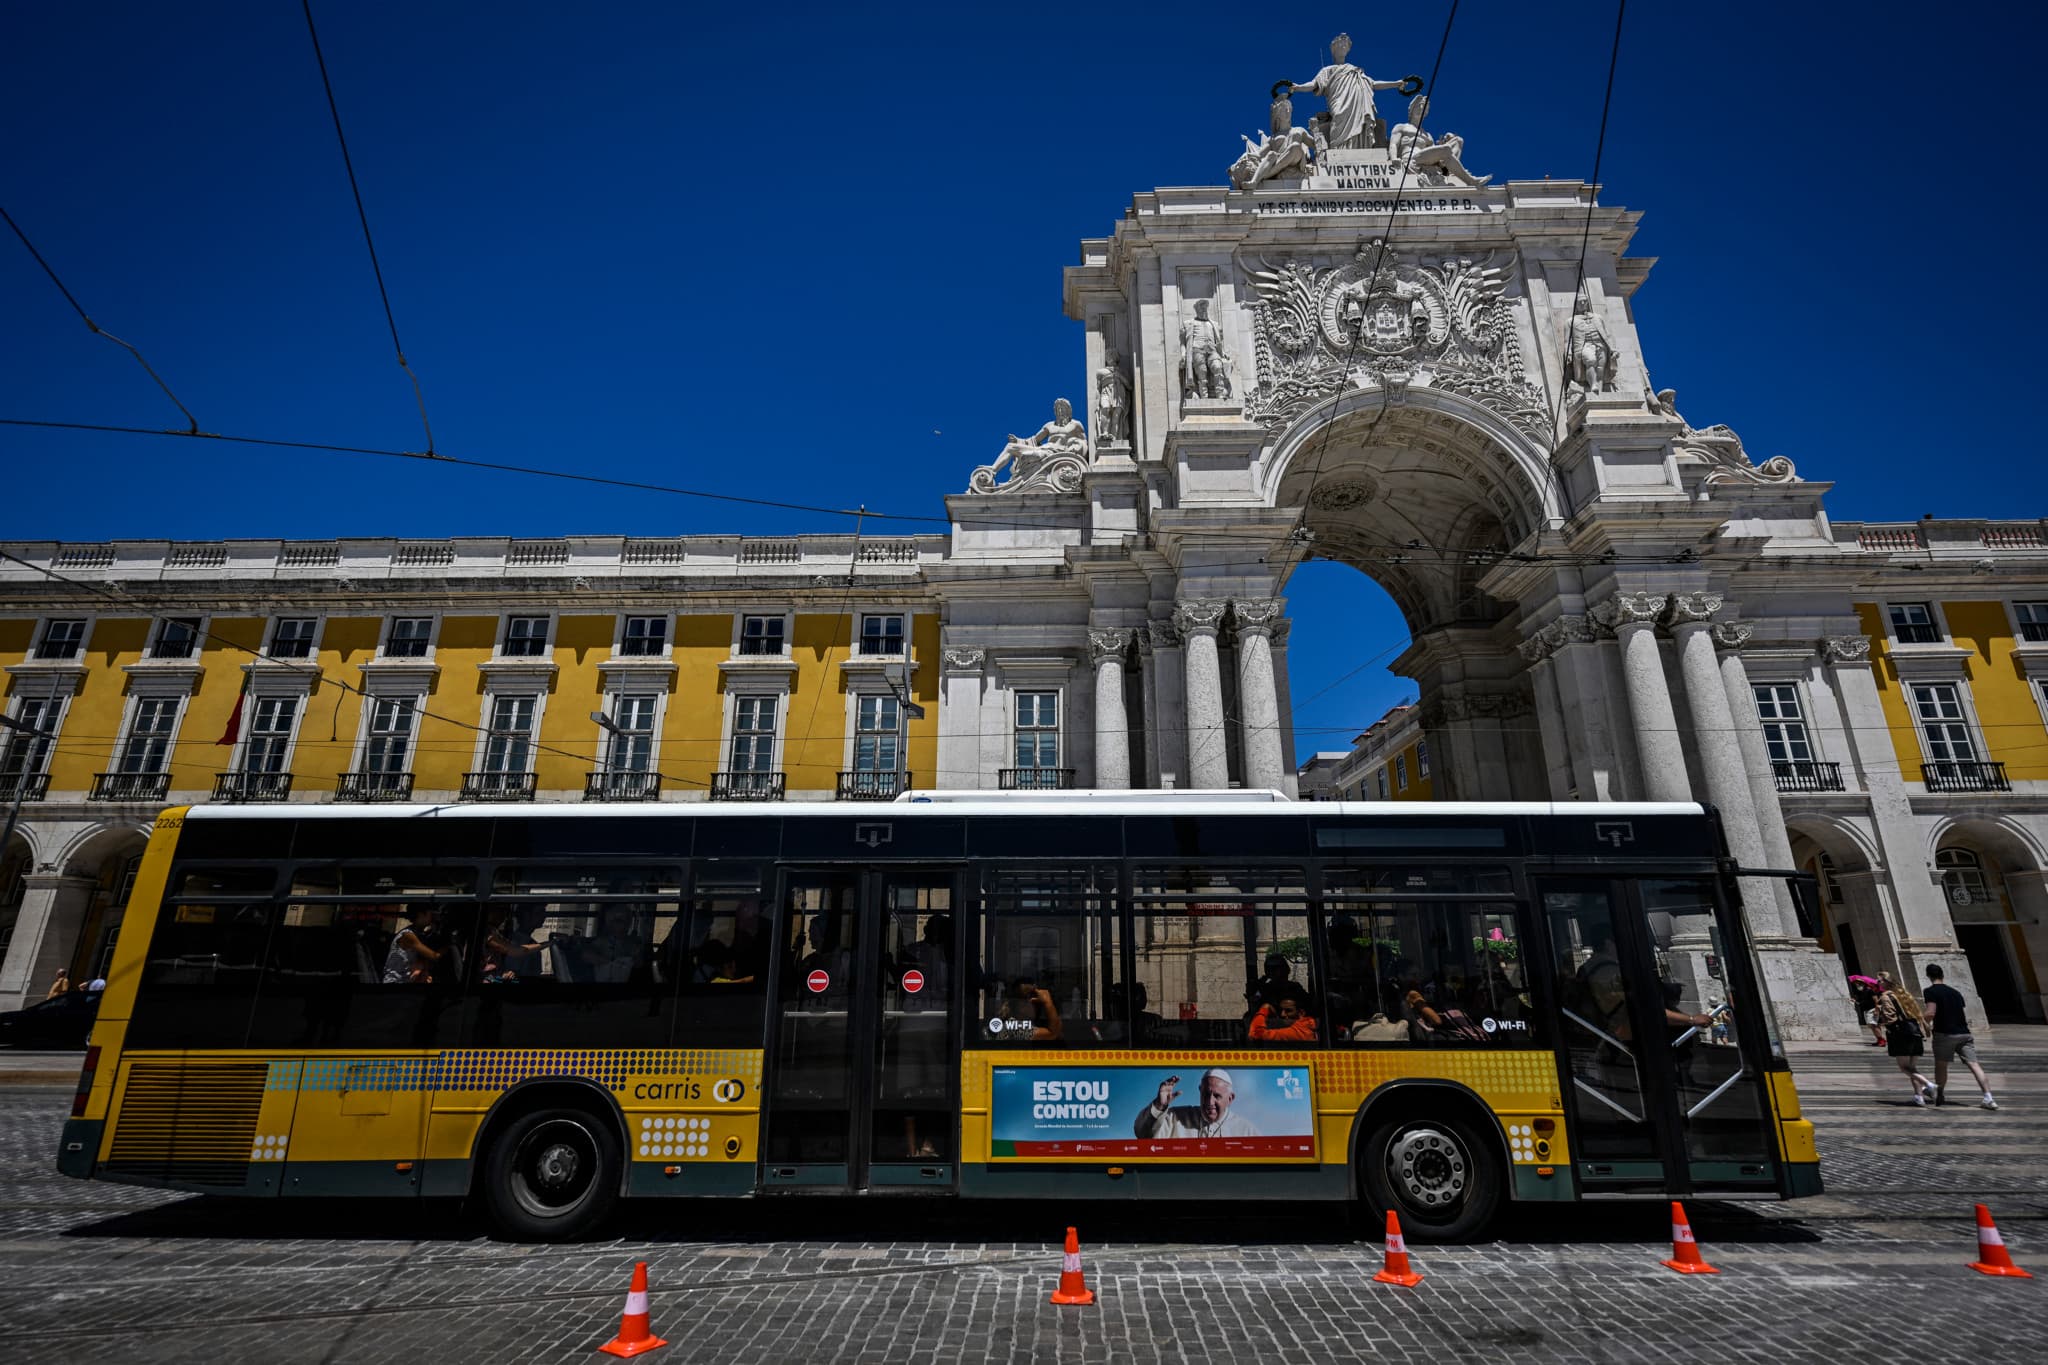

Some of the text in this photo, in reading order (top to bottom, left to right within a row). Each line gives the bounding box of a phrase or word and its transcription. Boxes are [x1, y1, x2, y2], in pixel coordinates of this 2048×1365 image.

[1325, 164, 1396, 177] VIRTVTIBVS
[1336, 178, 1391, 189] MAIORVM
[156, 818, 183, 829] 2262
[1005, 1020, 1032, 1030] WI-FI
[1498, 1020, 1526, 1031] WI-FI
[634, 1077, 701, 1100] carris
[1032, 1080, 1109, 1101] ESTOU
[1033, 1103, 1110, 1119] CONTIGO
